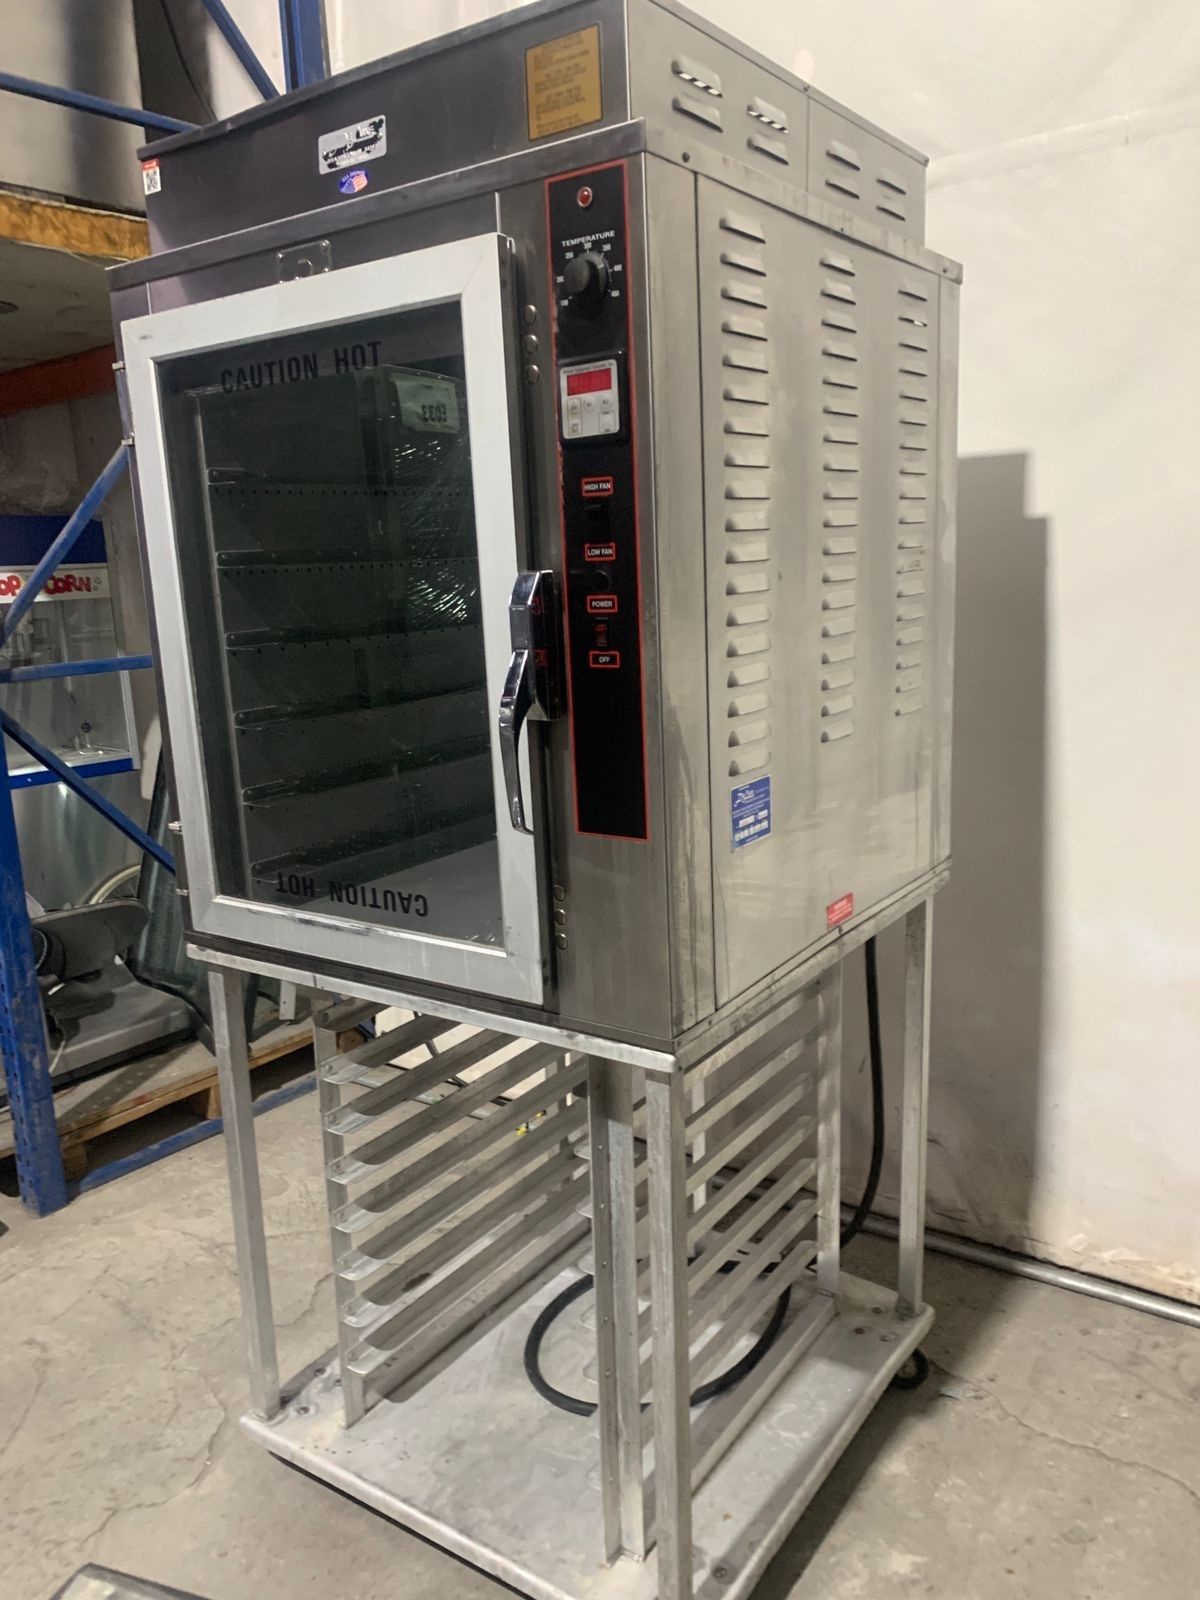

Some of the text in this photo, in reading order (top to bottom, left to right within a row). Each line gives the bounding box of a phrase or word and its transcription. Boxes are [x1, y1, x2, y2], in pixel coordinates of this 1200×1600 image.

[561, 230, 615, 247] TEMPERATURE
[219, 340, 382, 394] CAUTION HOT
[584, 482, 611, 491] HIGH FAN
[587, 547, 613, 556] LOW FAN
[591, 600, 614, 608] POWER
[275, 872, 429, 918] CAUTION HOT
